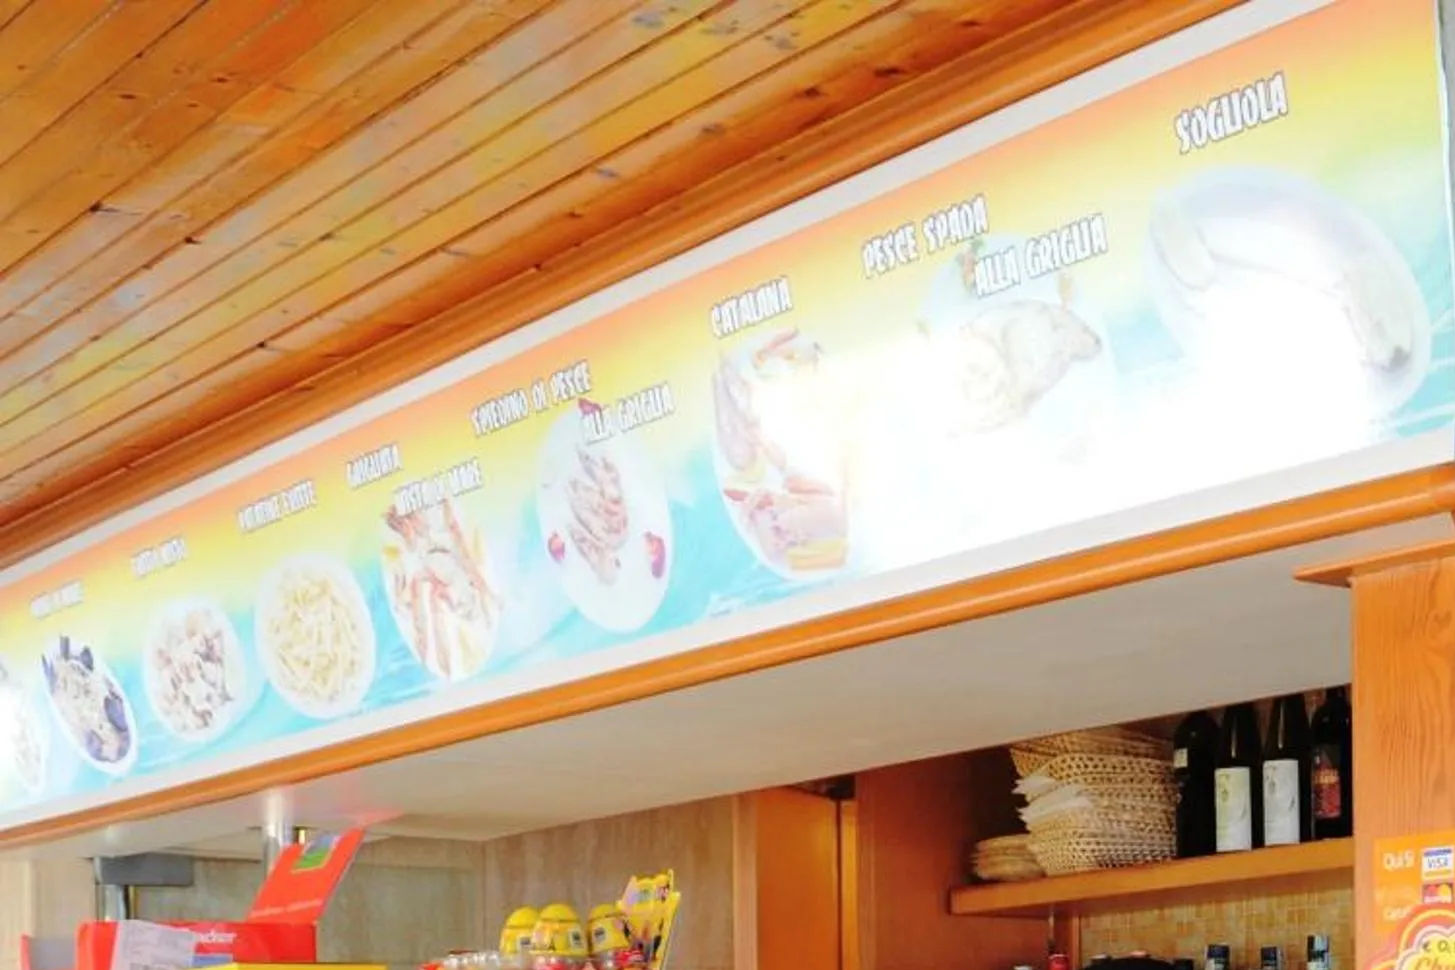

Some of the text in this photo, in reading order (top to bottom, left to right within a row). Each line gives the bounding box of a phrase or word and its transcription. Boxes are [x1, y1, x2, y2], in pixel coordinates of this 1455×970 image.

[1174, 70, 1288, 154] SOGLIOLA
[860, 194, 990, 278] PESCE SPADA
[972, 213, 1109, 298] ALLA GRIGLIA
[710, 275, 793, 338] CATALANA
[549, 359, 592, 401] PESCE
[617, 381, 675, 434] GRIGLIA
